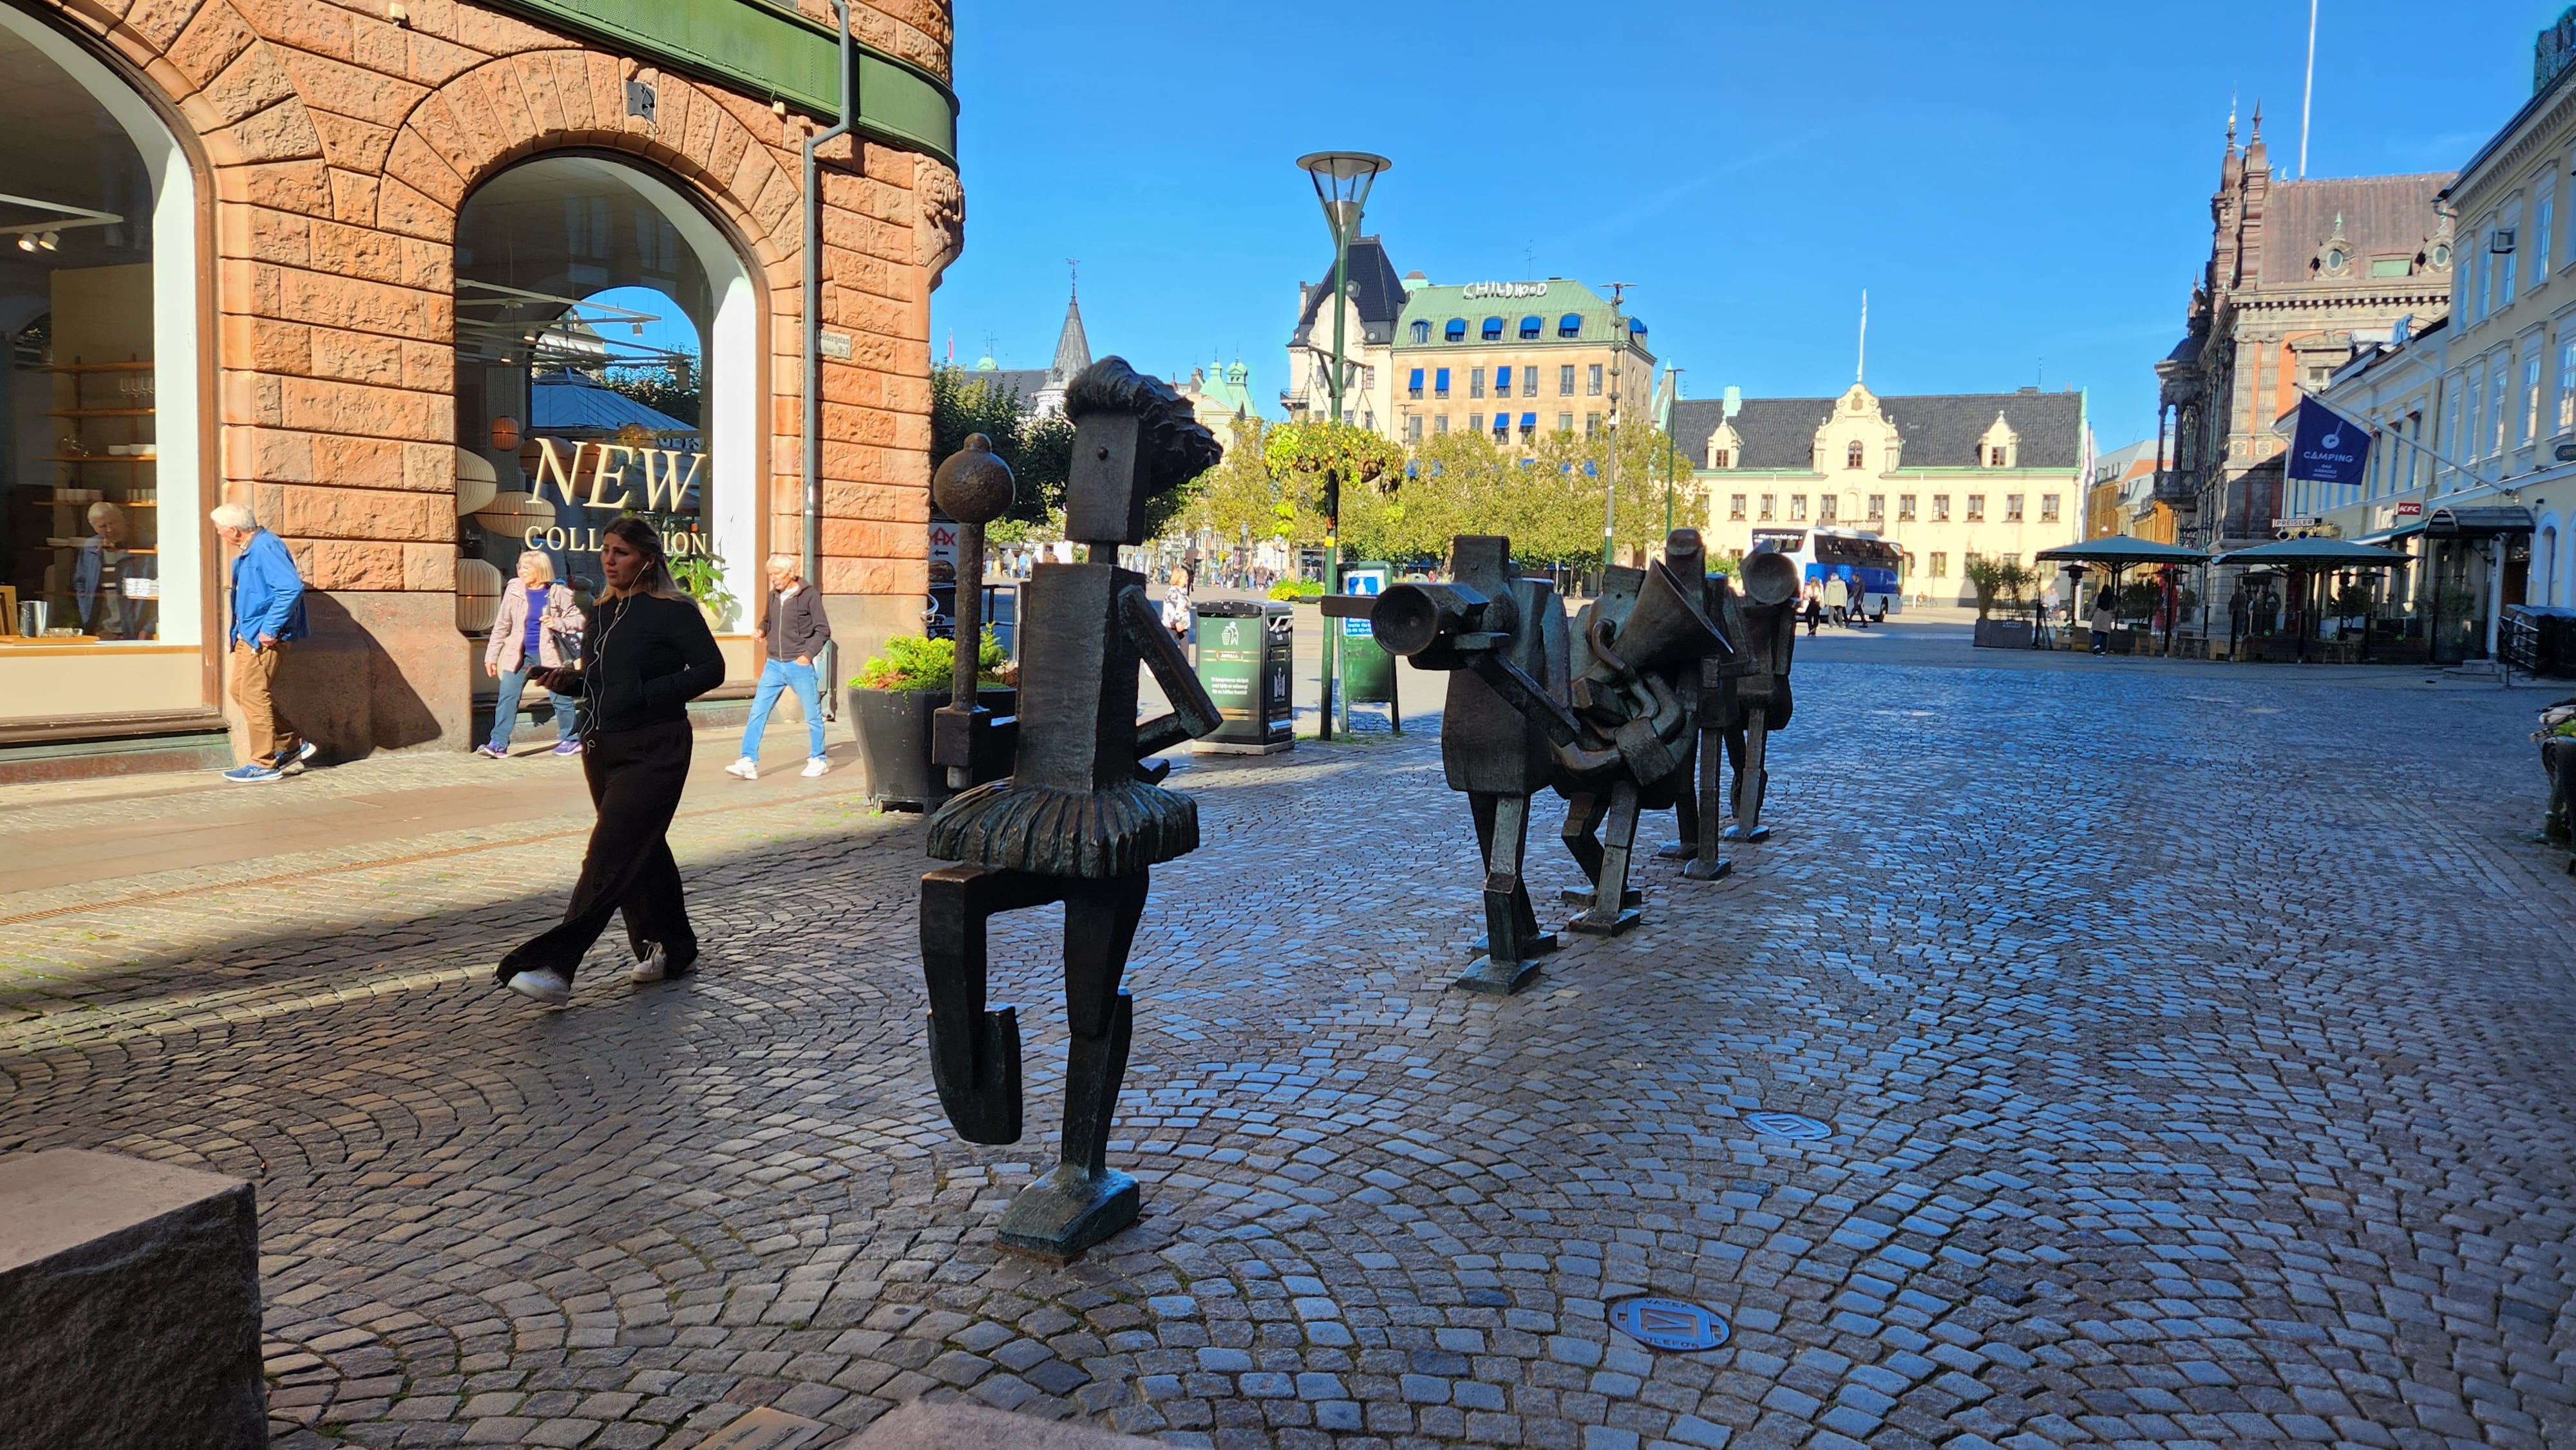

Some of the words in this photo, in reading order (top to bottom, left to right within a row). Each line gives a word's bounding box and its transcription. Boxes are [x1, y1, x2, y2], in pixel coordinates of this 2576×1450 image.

[1463, 279, 1548, 297] CHILDHOOD
[2303, 451, 2354, 463] CAMPING
[525, 437, 706, 513] NEW
[525, 525, 707, 555] COLLION
